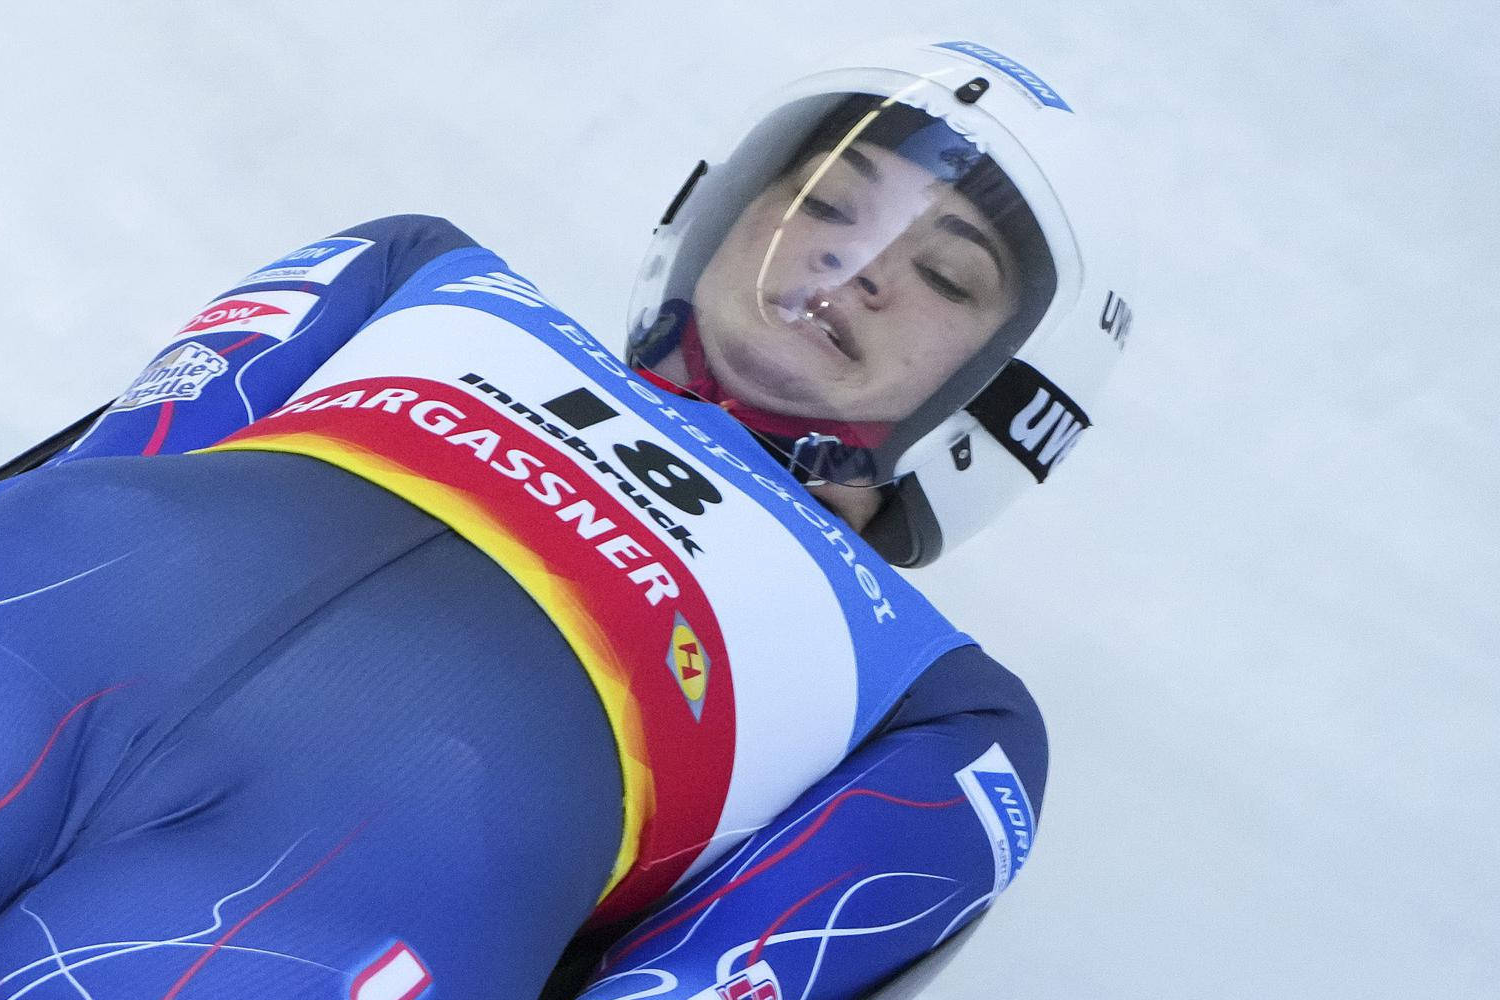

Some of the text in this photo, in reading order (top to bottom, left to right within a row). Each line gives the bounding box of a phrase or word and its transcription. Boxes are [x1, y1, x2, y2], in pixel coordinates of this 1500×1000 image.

[268, 388, 680, 606] HARGASSNER
[458, 373, 704, 558] Innsbruck
[541, 387, 723, 516] 18
